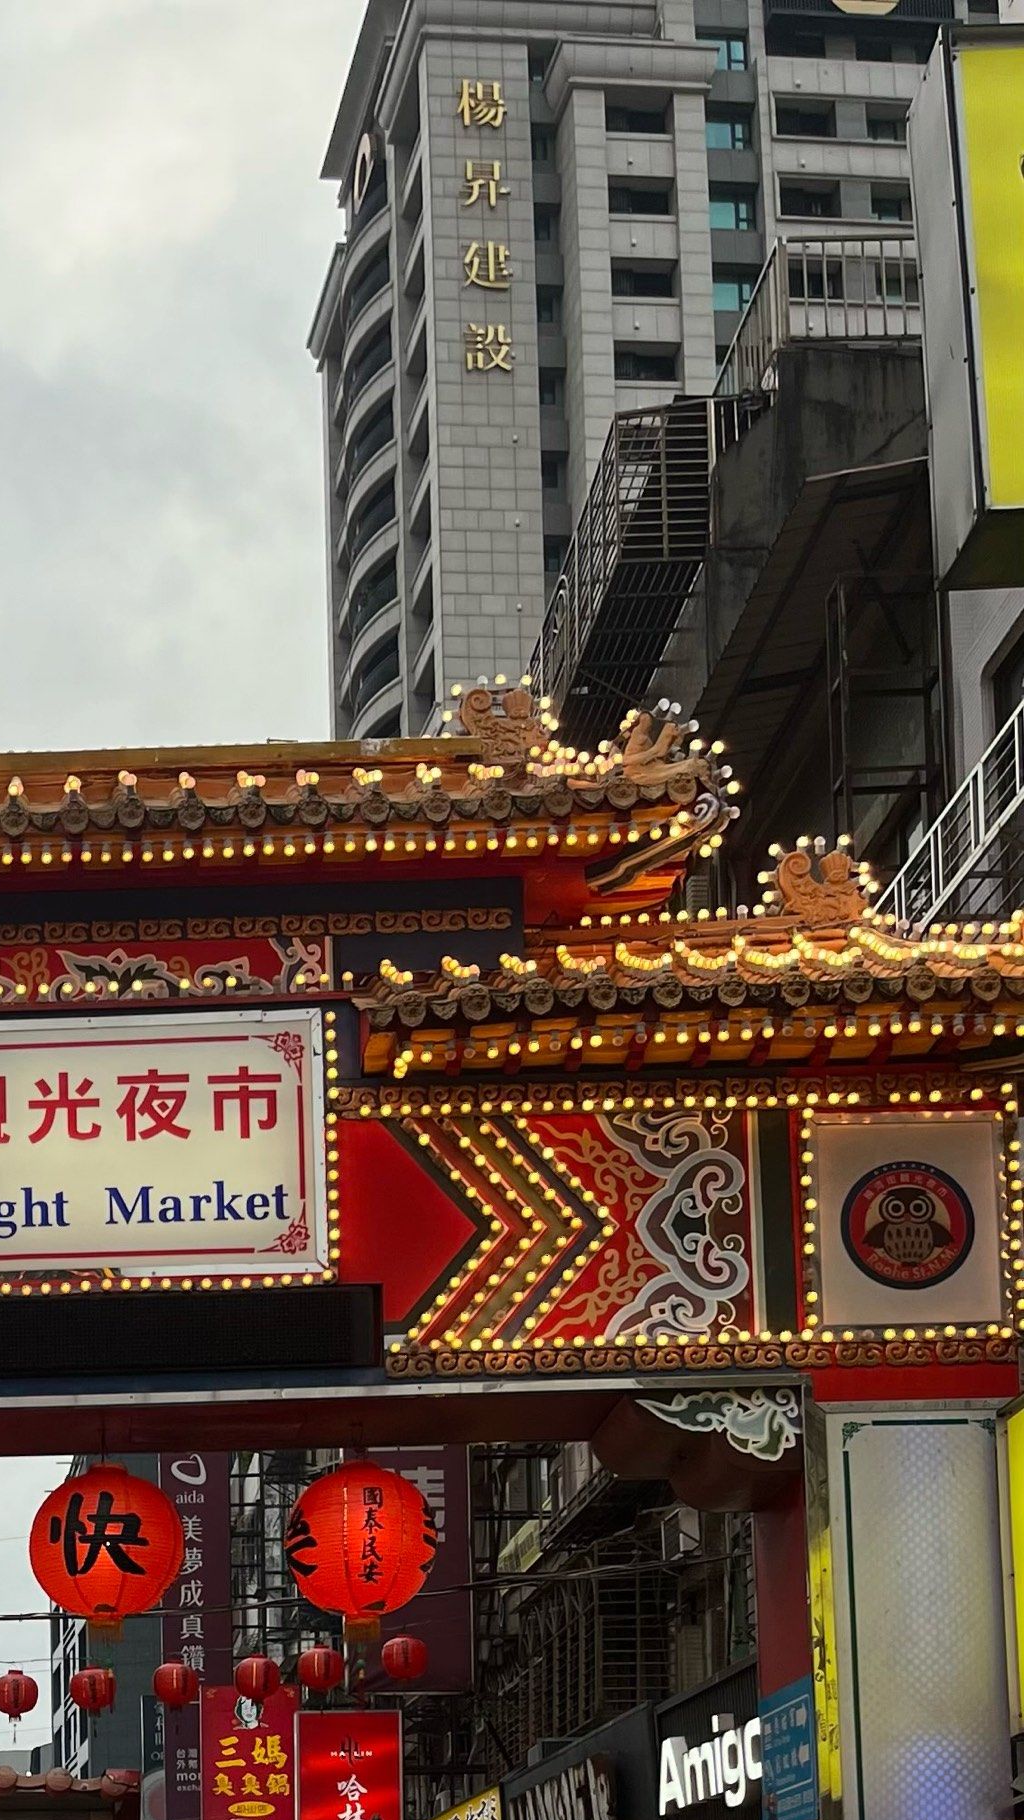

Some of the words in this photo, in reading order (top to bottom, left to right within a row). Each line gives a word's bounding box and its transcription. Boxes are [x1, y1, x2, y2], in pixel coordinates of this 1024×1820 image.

[456, 78, 514, 374] 楊昇建設
[104, 1180, 291, 1226] Market
[175, 1489, 205, 1504] aida
[49, 1491, 150, 1577] 快
[357, 1486, 385, 1584] 國泰民安
[179, 1514, 206, 1681] 美夢成真鑽
[212, 1772, 290, 1797] 臭臭鍋
[214, 1734, 288, 1770] 三媽
